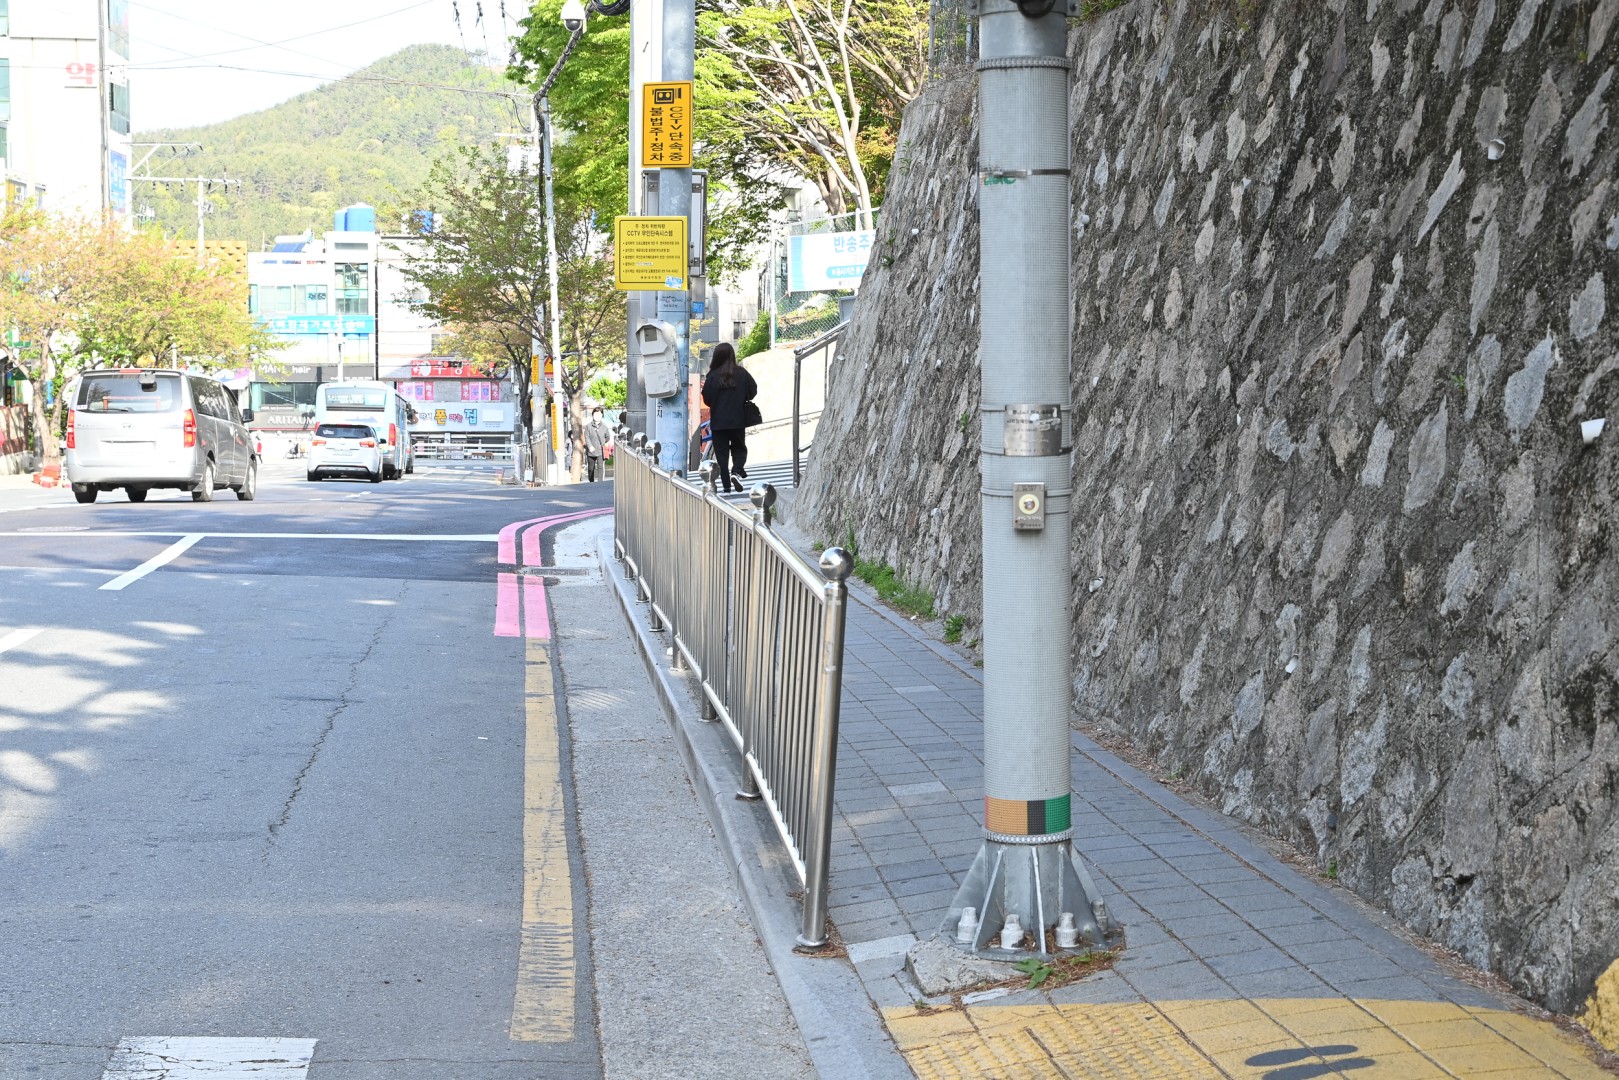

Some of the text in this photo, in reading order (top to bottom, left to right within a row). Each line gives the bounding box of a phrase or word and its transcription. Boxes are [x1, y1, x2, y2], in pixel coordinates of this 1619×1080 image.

[65, 62, 96, 85] 약
[834, 234, 875, 253] 반송주
[292, 365, 311, 374] hair
[268, 415, 316, 425] ARITAUM
[434, 409, 447, 425] 폰
[464, 409, 477, 425] 집
